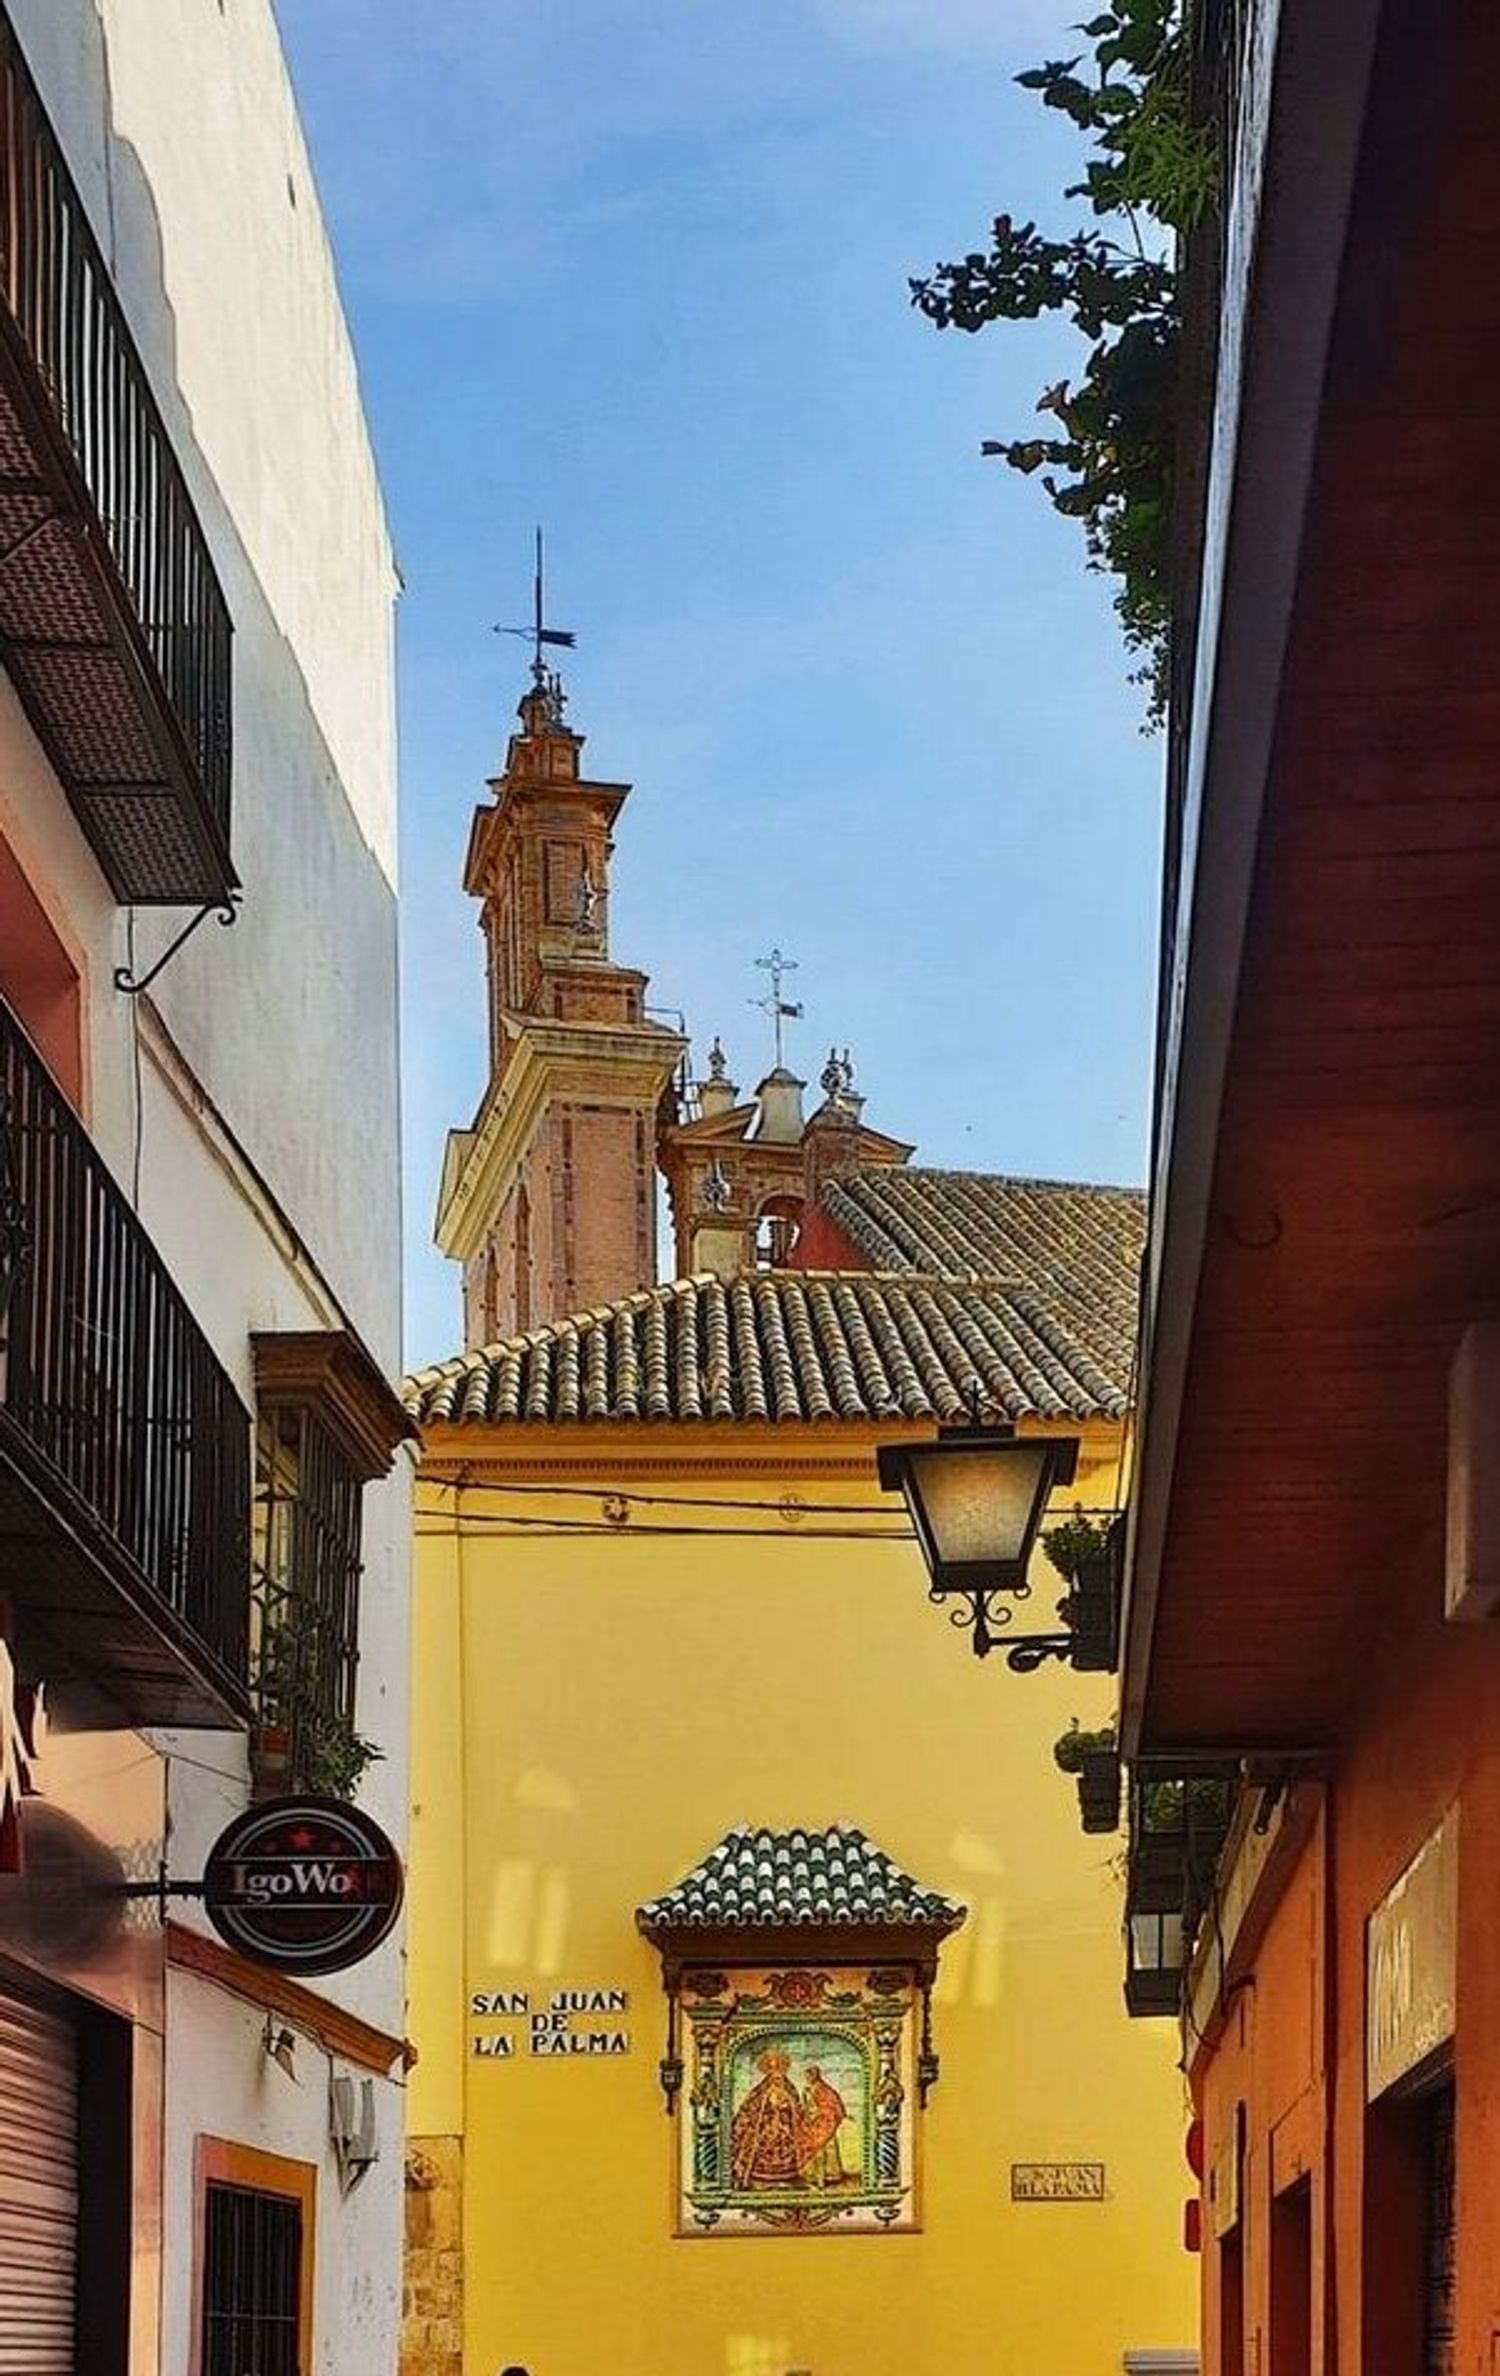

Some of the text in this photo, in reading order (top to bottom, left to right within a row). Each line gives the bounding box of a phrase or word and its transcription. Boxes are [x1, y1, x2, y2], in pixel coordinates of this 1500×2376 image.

[472, 1990, 627, 2015] SAN JUAN
[531, 2013, 568, 2032] DE
[474, 2033, 627, 2056] LA PALMA
